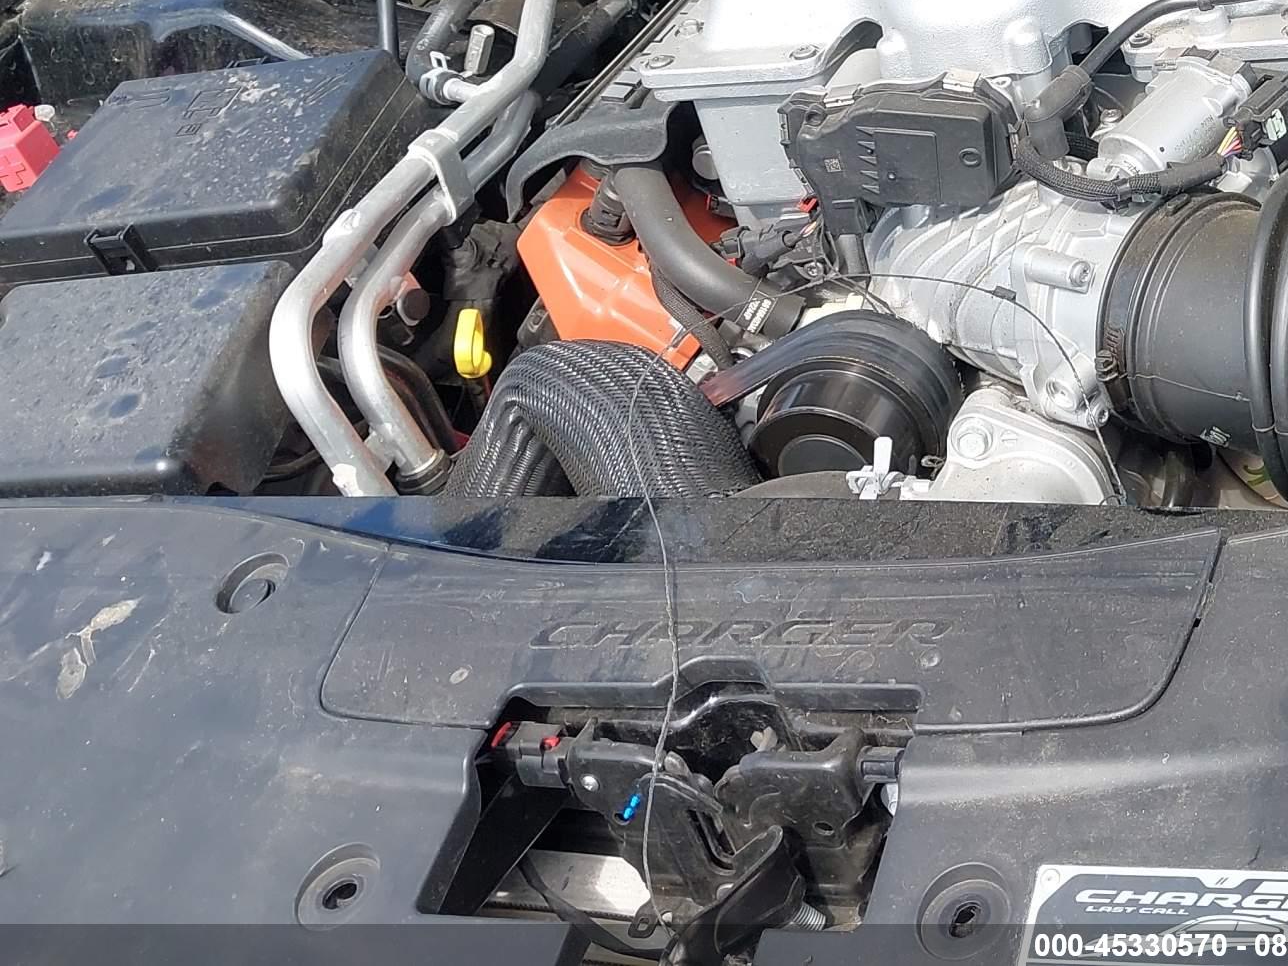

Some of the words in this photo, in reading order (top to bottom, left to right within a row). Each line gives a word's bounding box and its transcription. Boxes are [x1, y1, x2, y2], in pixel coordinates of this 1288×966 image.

[528, 618, 955, 650] CHARGER
[1085, 906, 1137, 914] LAST
[1138, 907, 1189, 915] CALL
